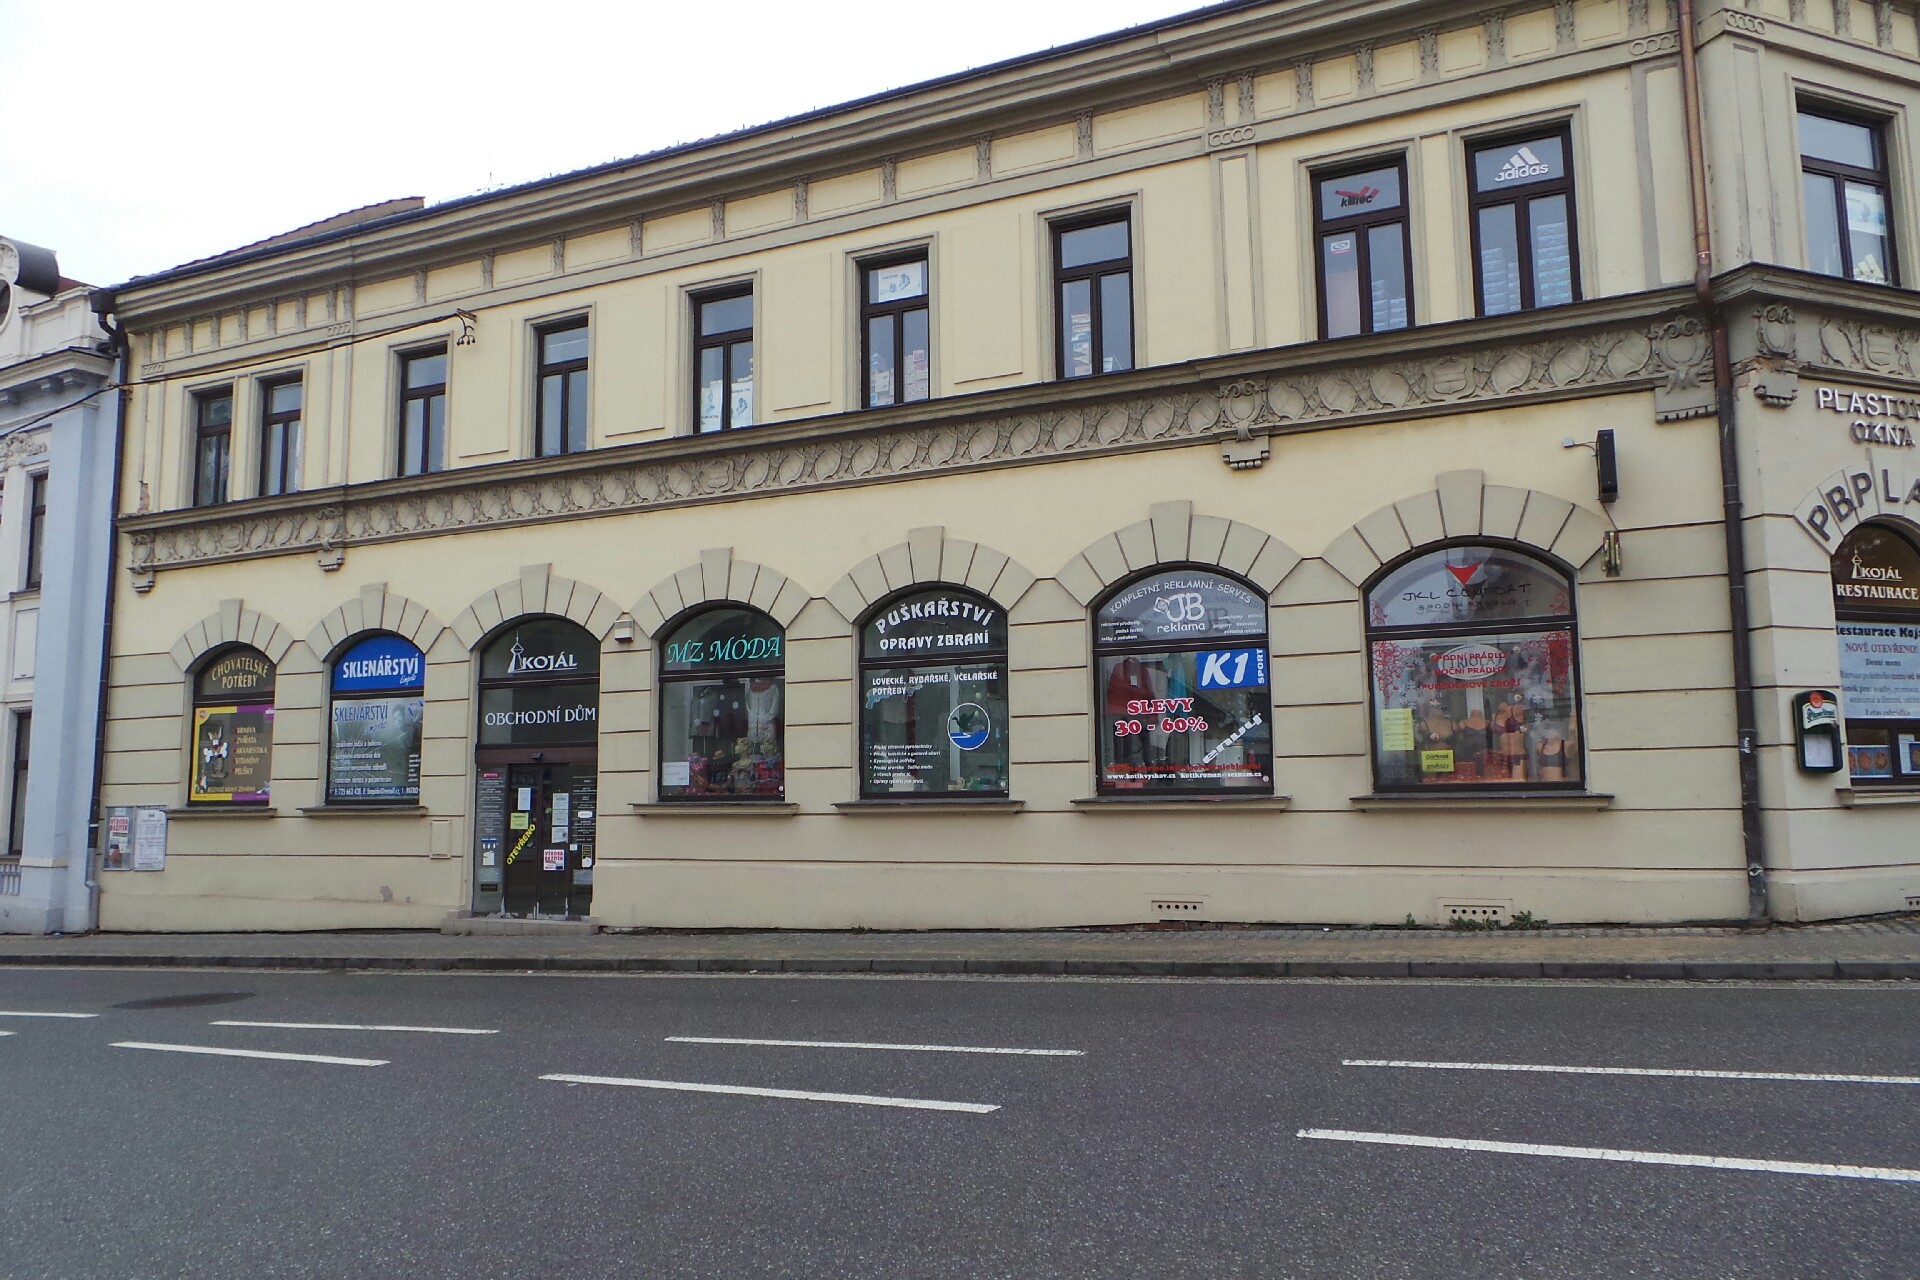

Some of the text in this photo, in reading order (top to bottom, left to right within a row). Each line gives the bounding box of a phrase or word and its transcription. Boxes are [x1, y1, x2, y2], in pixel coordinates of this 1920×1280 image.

[1494, 161, 1549, 182] adidas
[1851, 419, 1916, 447] OKNA
[1861, 566, 1903, 580] KOJÁL
[1110, 579, 1253, 614] KOMPLETNÍ REKLAMNÍ SERVIS
[1401, 591, 1440, 602] JKL
[1836, 583, 1919, 600] RESTAURACE
[875, 597, 995, 634] PUŠKAŘSTVÍ
[1166, 592, 1206, 622] JB
[1156, 620, 1206, 634] reklama
[667, 634, 782, 664] MZ MÓDA
[879, 629, 990, 651] OPRAVY ZBRANÍ
[212, 657, 271, 681] CHOVATELSKÉ
[343, 653, 419, 679] SKLENÁŘSTVÍ
[522, 651, 578, 671] KOJÁL
[1202, 651, 1249, 687] K1
[1256, 648, 1265, 685] SPORT
[222, 672, 258, 689] POTŘEBY
[872, 669, 998, 686] LOVECKÉ, RYBÁŘSKÉ, VČELAŘSKÉ
[872, 686, 907, 696] POTŘEBY
[334, 701, 389, 722] SKLENÁŘSTVÍ
[485, 704, 596, 726] OBCHODNÍ DŮM
[1127, 698, 1194, 715] SLEVY
[1114, 720, 1142, 737] 30
[1161, 716, 1209, 733] 60%
[506, 824, 536, 865] OTEVŘENO
